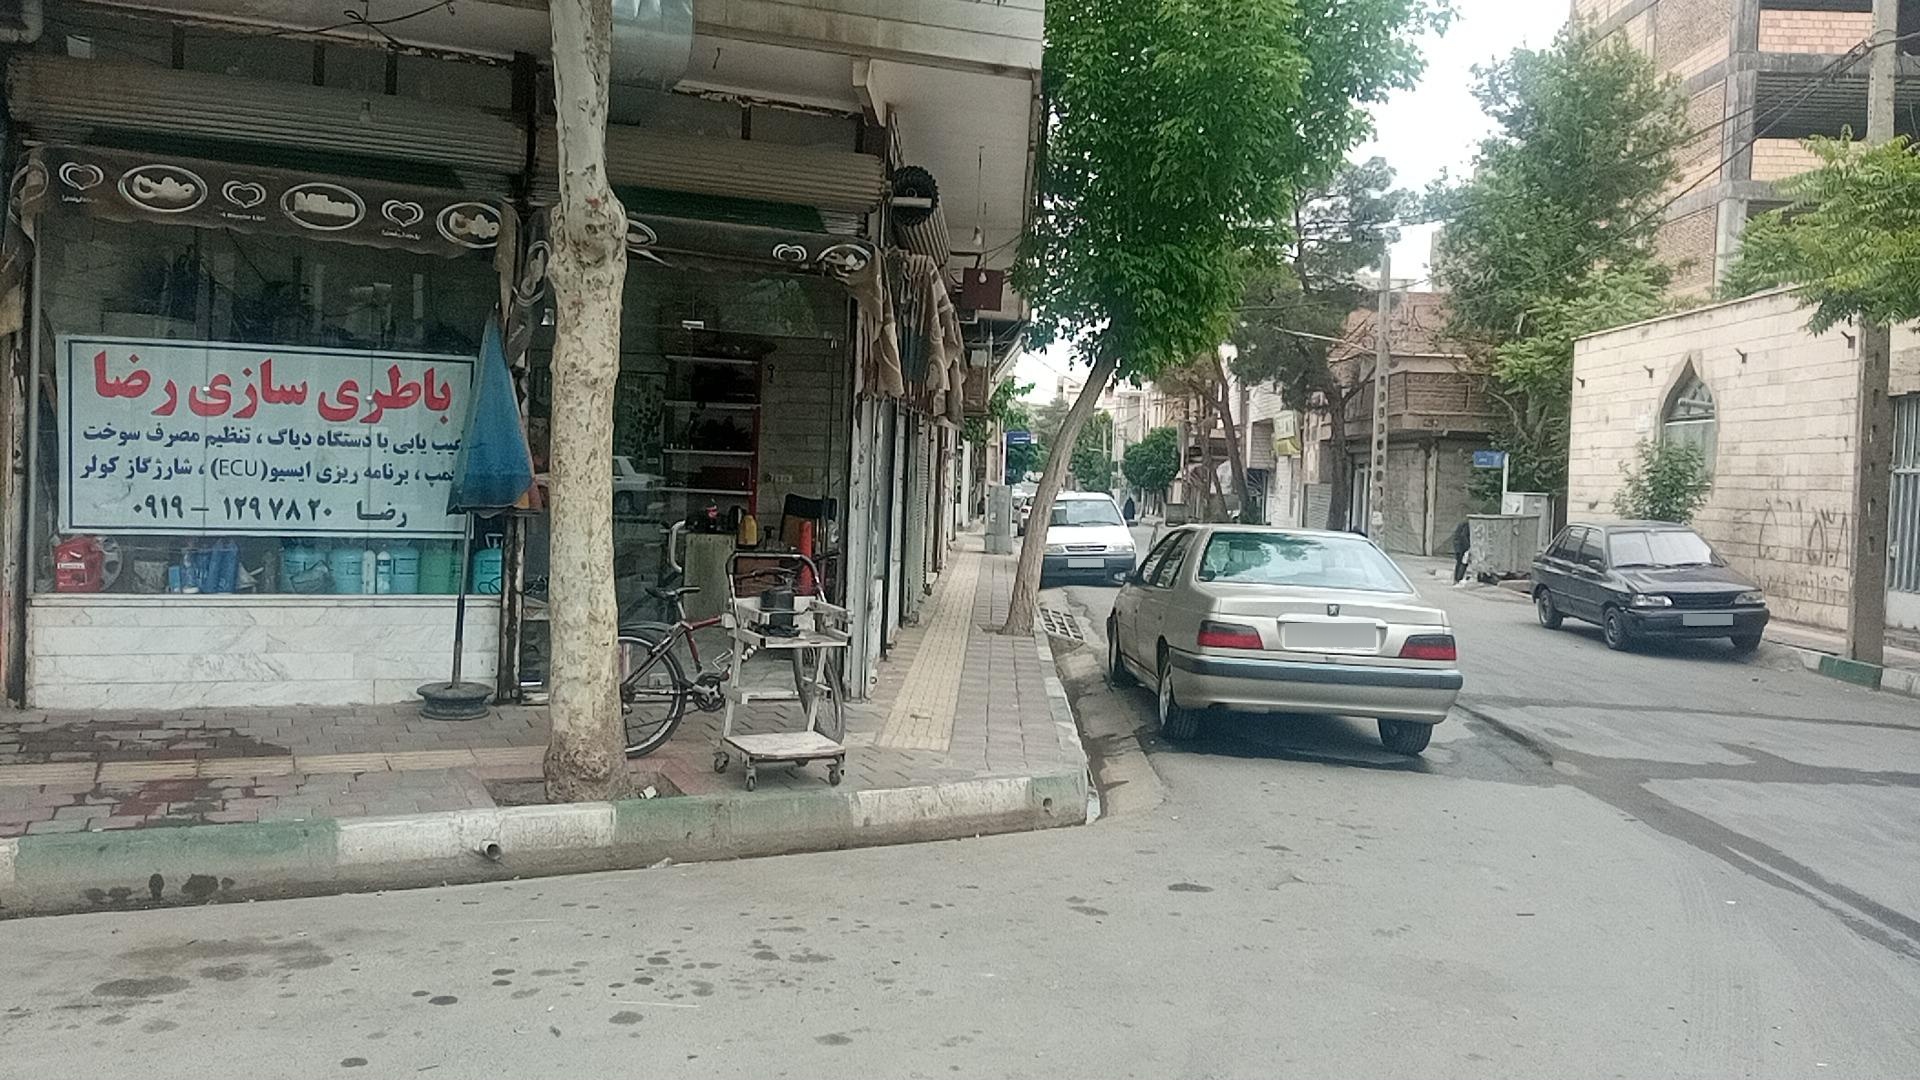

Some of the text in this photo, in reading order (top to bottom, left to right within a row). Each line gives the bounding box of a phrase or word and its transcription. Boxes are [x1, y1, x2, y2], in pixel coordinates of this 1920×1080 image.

[93, 350, 451, 425] باطری سازی رضا
[83, 422, 140, 446] سوخت
[146, 423, 200, 448] مصرف
[205, 426, 251, 448] تنظیم
[267, 429, 312, 449] دیاگ
[317, 429, 370, 449] دستگاه
[377, 432, 389, 453] با
[393, 433, 426, 455] یابی
[79, 454, 119, 479] کولر
[316, 464, 358, 485] ریزی
[363, 463, 409, 485] برنامه
[133, 494, 184, 519] ۰۹۱۹
[356, 499, 407, 528] رضا
